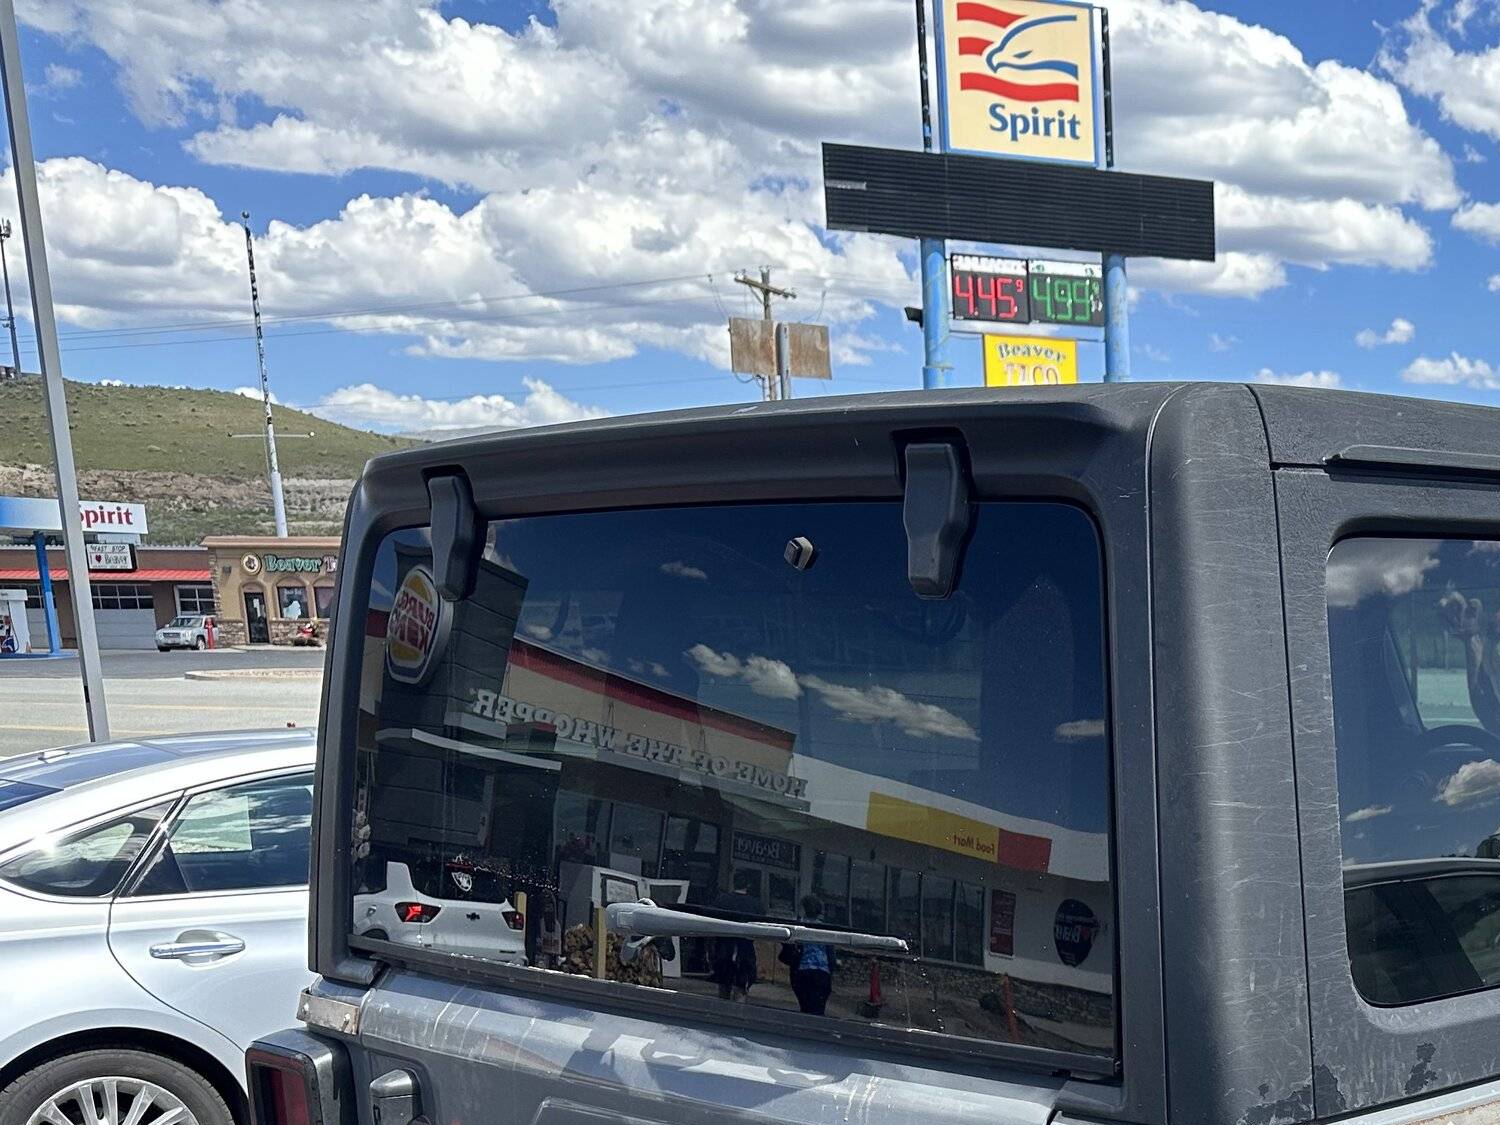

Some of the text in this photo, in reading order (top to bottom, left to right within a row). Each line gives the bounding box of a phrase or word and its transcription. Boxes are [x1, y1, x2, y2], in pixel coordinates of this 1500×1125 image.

[988, 102, 1081, 142] Spirit
[998, 342, 1066, 362] Beaver
[263, 554, 322, 573] Beaver
